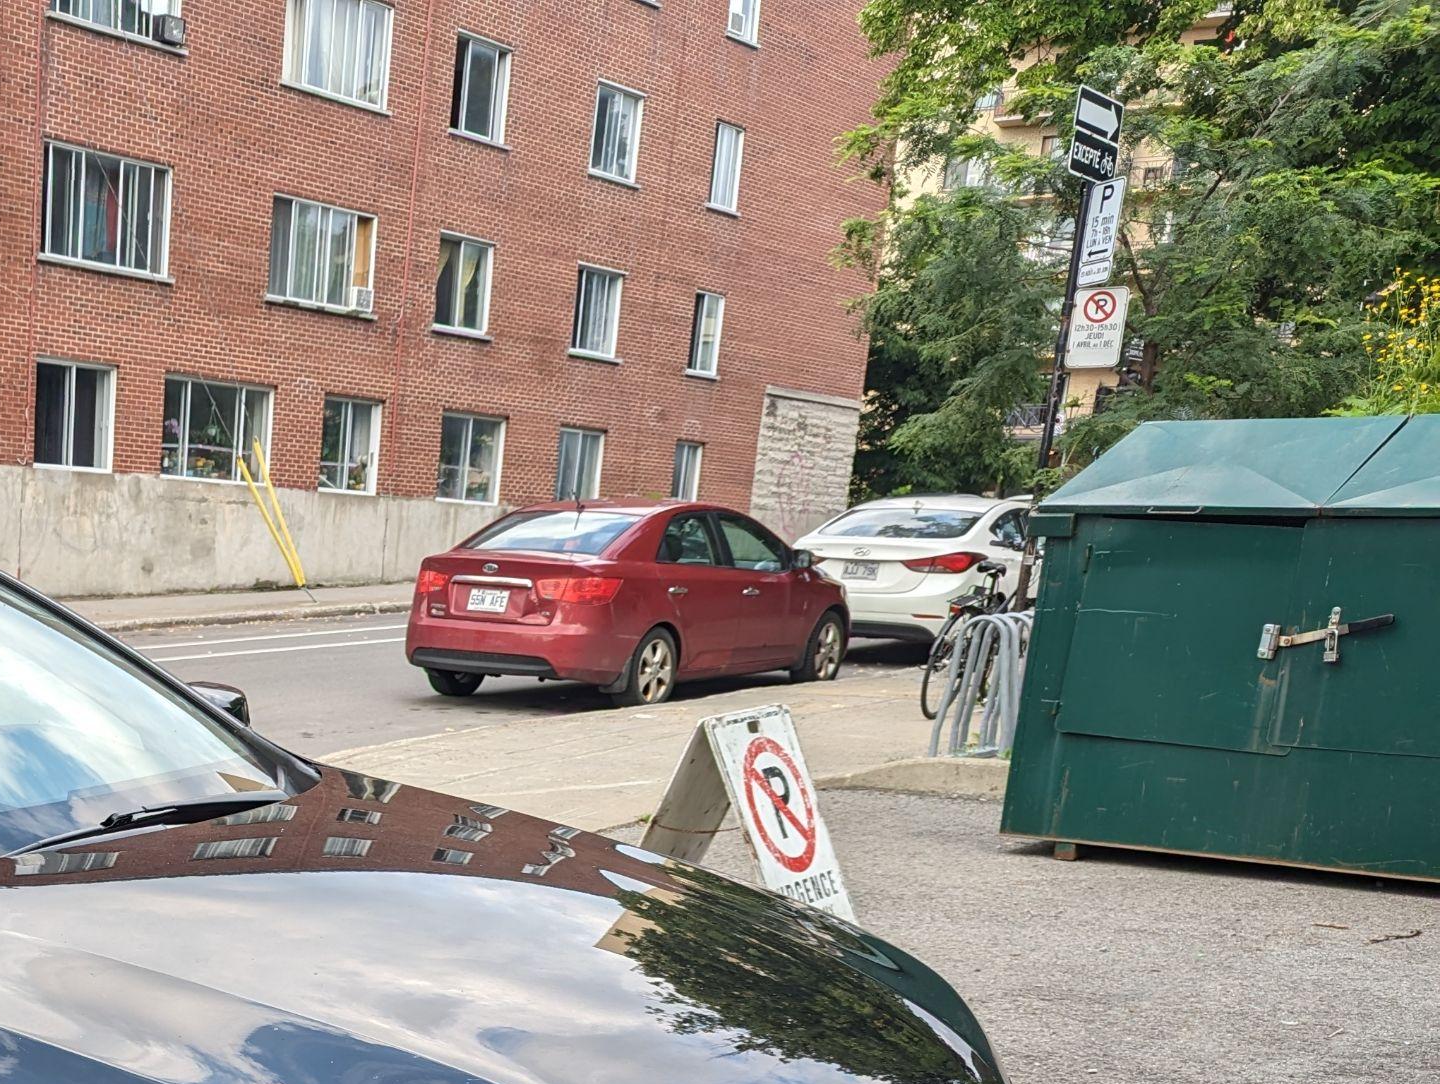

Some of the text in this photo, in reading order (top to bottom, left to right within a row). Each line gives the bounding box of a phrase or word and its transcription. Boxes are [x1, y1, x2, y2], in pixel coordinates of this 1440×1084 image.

[1073, 141, 1101, 169] EXCEPTÉ
[1100, 184, 1115, 213] P
[1091, 213, 1115, 228] 15 min
[1086, 238, 1097, 249] LUN
[1101, 235, 1113, 245] VEN
[1084, 332, 1105, 340] JEUDI
